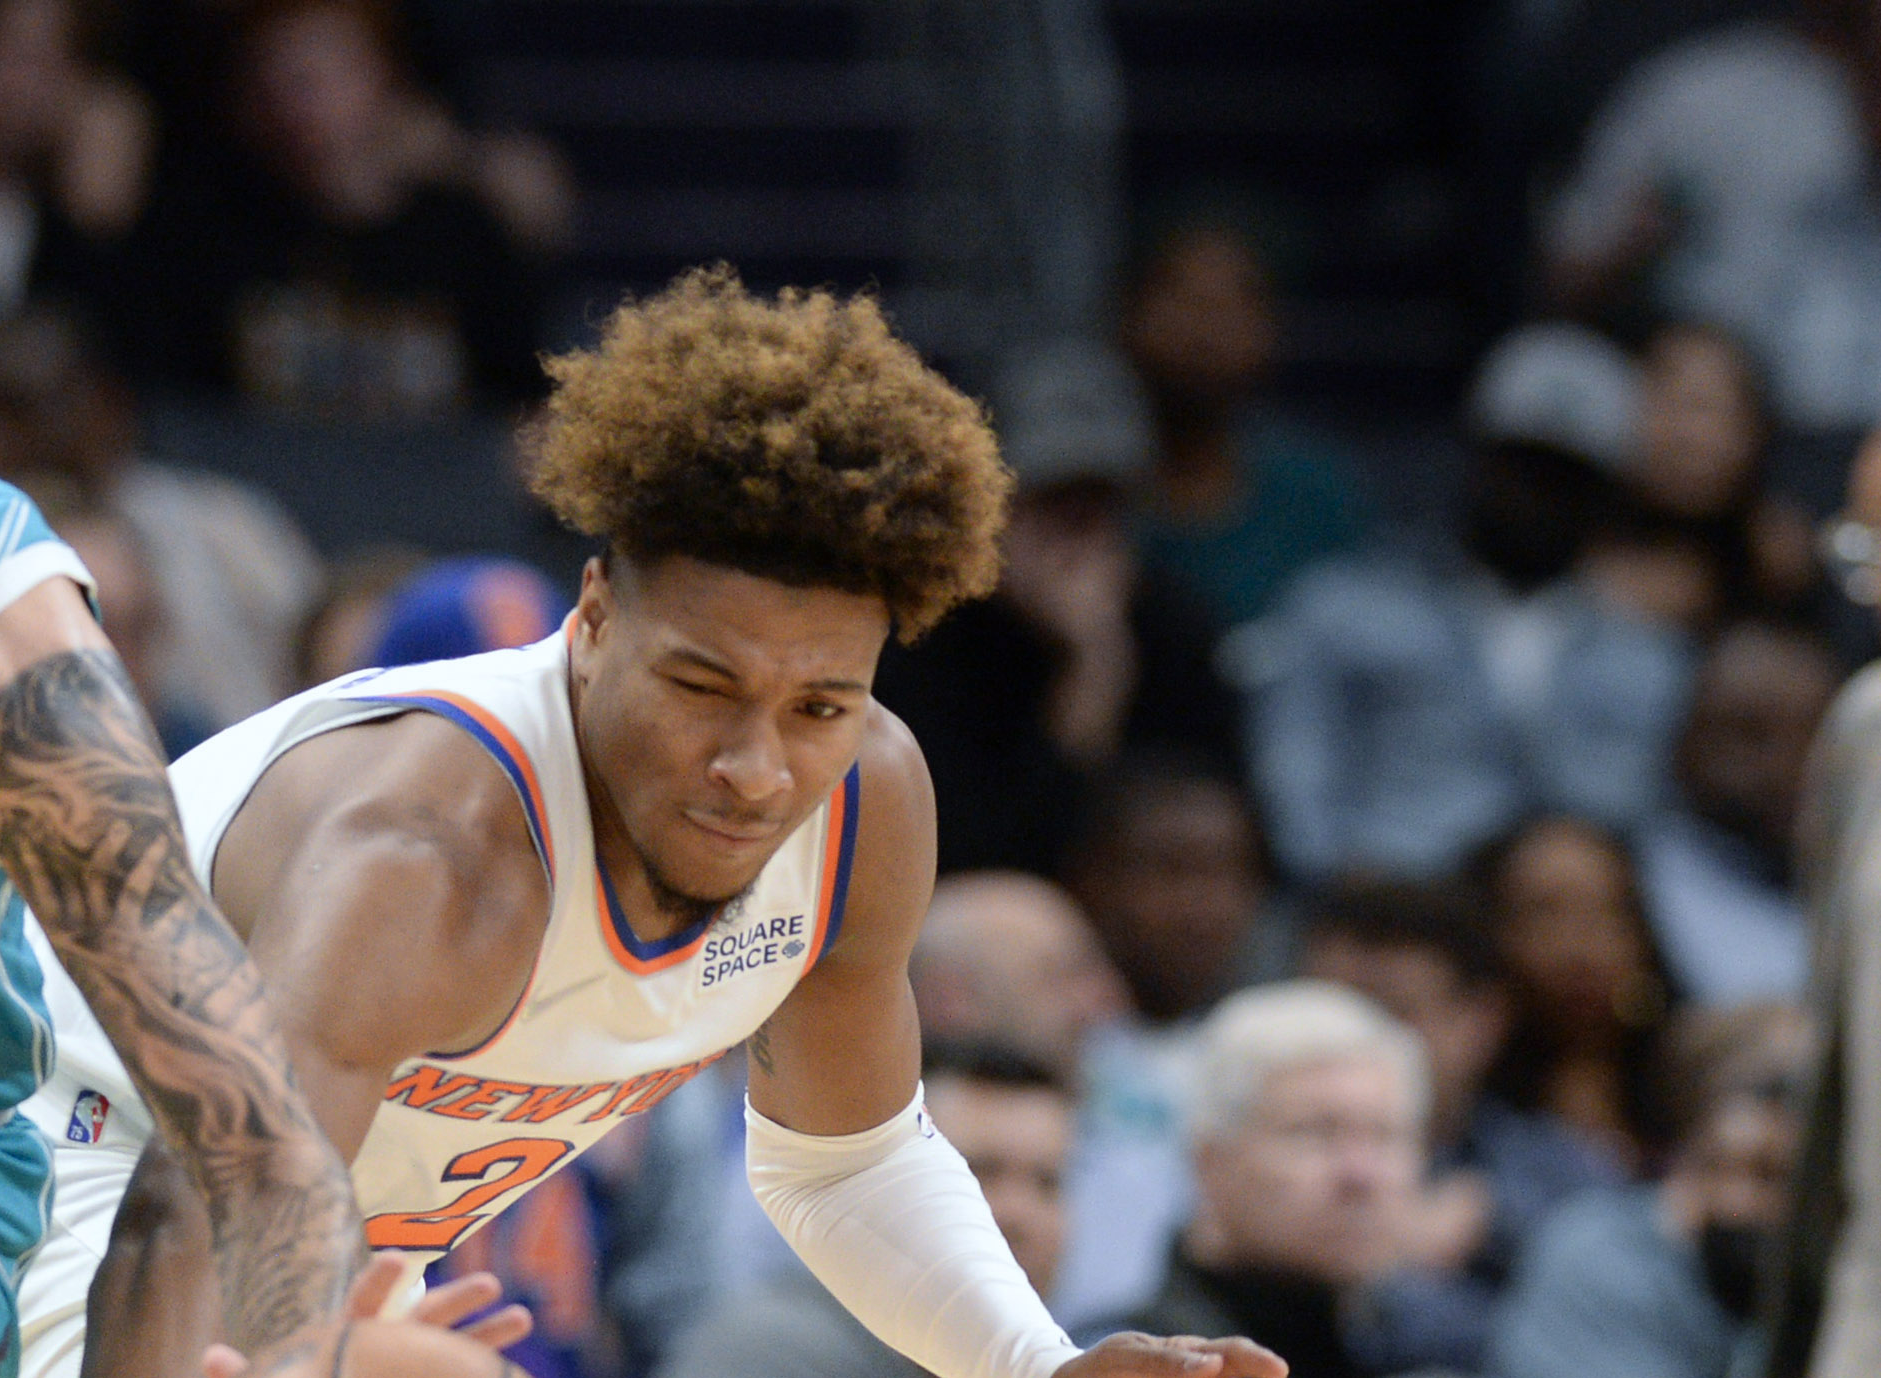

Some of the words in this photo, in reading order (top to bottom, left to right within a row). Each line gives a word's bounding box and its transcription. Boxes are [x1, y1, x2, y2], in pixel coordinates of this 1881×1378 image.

[702, 943, 779, 987] SPACE
[704, 915, 804, 962] SQUARE
[385, 1065, 616, 1125] NEW
[364, 1136, 576, 1252] 2
